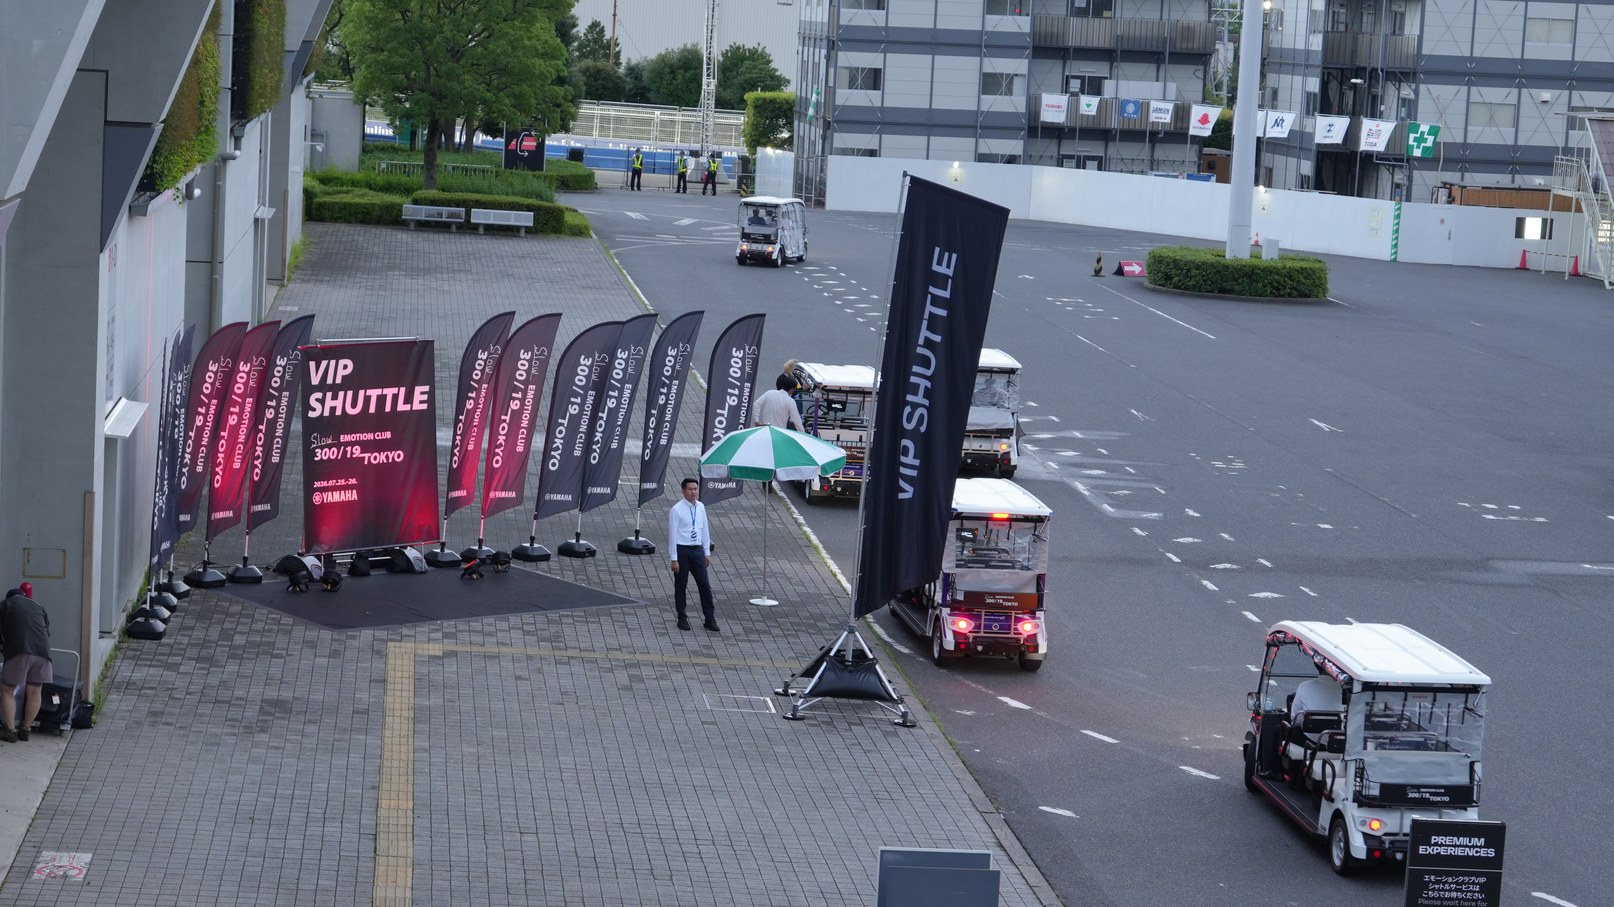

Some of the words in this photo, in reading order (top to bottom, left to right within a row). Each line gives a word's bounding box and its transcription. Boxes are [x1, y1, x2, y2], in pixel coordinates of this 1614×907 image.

[676, 342, 690, 373] Slow
[745, 344, 758, 375] Slow
[903, 246, 957, 433] SHUTTLE
[215, 356, 231, 390] Slow
[248, 356, 266, 390] Slow
[285, 350, 301, 384] Slow
[309, 358, 354, 385] VIP
[466, 350, 488, 410] 300/19
[486, 344, 501, 377] Slow
[510, 349, 532, 410] 300/19
[531, 344, 548, 378] Slow
[591, 352, 608, 384] Slow
[606, 348, 628, 408] 300/19
[628, 344, 644, 377] Slow
[658, 346, 677, 405] 300/19
[726, 348, 744, 406] 300/19
[196, 360, 218, 426] 300/19
[228, 362, 250, 425] 300/19
[266, 356, 287, 418] 300/19
[308, 386, 430, 418] SHUTTLE
[568, 354, 592, 414] 300/19
[616, 384, 632, 424] EMOTION
[664, 380, 679, 421] EMOTION
[740, 382, 751, 424] EMOTION
[202, 399, 218, 445] EMOTION
[238, 398, 253, 442] EMOTION
[275, 392, 290, 436] EMOTION
[473, 384, 488, 425] EMOTION
[520, 384, 536, 427] EMOTION
[579, 390, 596, 432] EMOTION
[712, 402, 728, 445] TOK
[254, 417, 266, 481] TOKYO
[272, 438, 282, 463] CLUB
[310, 432, 337, 448] Slow
[340, 432, 374, 442] EMOTION
[374, 431, 392, 440] CLUB
[452, 408, 466, 468] TOKYO
[468, 428, 477, 450] CLUB
[492, 408, 512, 468] TOKYO
[516, 429, 526, 452] CLUB
[548, 412, 570, 471] TOKYO
[574, 433, 584, 456] CLUB
[590, 406, 608, 464] TOKYO
[644, 404, 658, 460] TOKYO
[660, 422, 670, 445] CLUB
[181, 423, 197, 489] TOKYO
[196, 447, 206, 472] CLUB
[214, 423, 229, 488] TOKYO
[232, 444, 244, 468] CLUB
[314, 446, 360, 460] 300/19
[358, 450, 404, 464] TOKYO
[898, 438, 921, 500] VIP
[214, 510, 234, 518] YAMAHA
[254, 504, 271, 512] YAMAHA
[322, 490, 358, 503] YAMAHA
[550, 493, 572, 501] YAMAHA
[1418, 846, 1495, 858] EXPERIENCES
[1431, 836, 1484, 846] PREMIUM
[1422, 890, 1484, 899] こちらでお待ちください
[1428, 883, 1480, 891] シャトルサービスは
